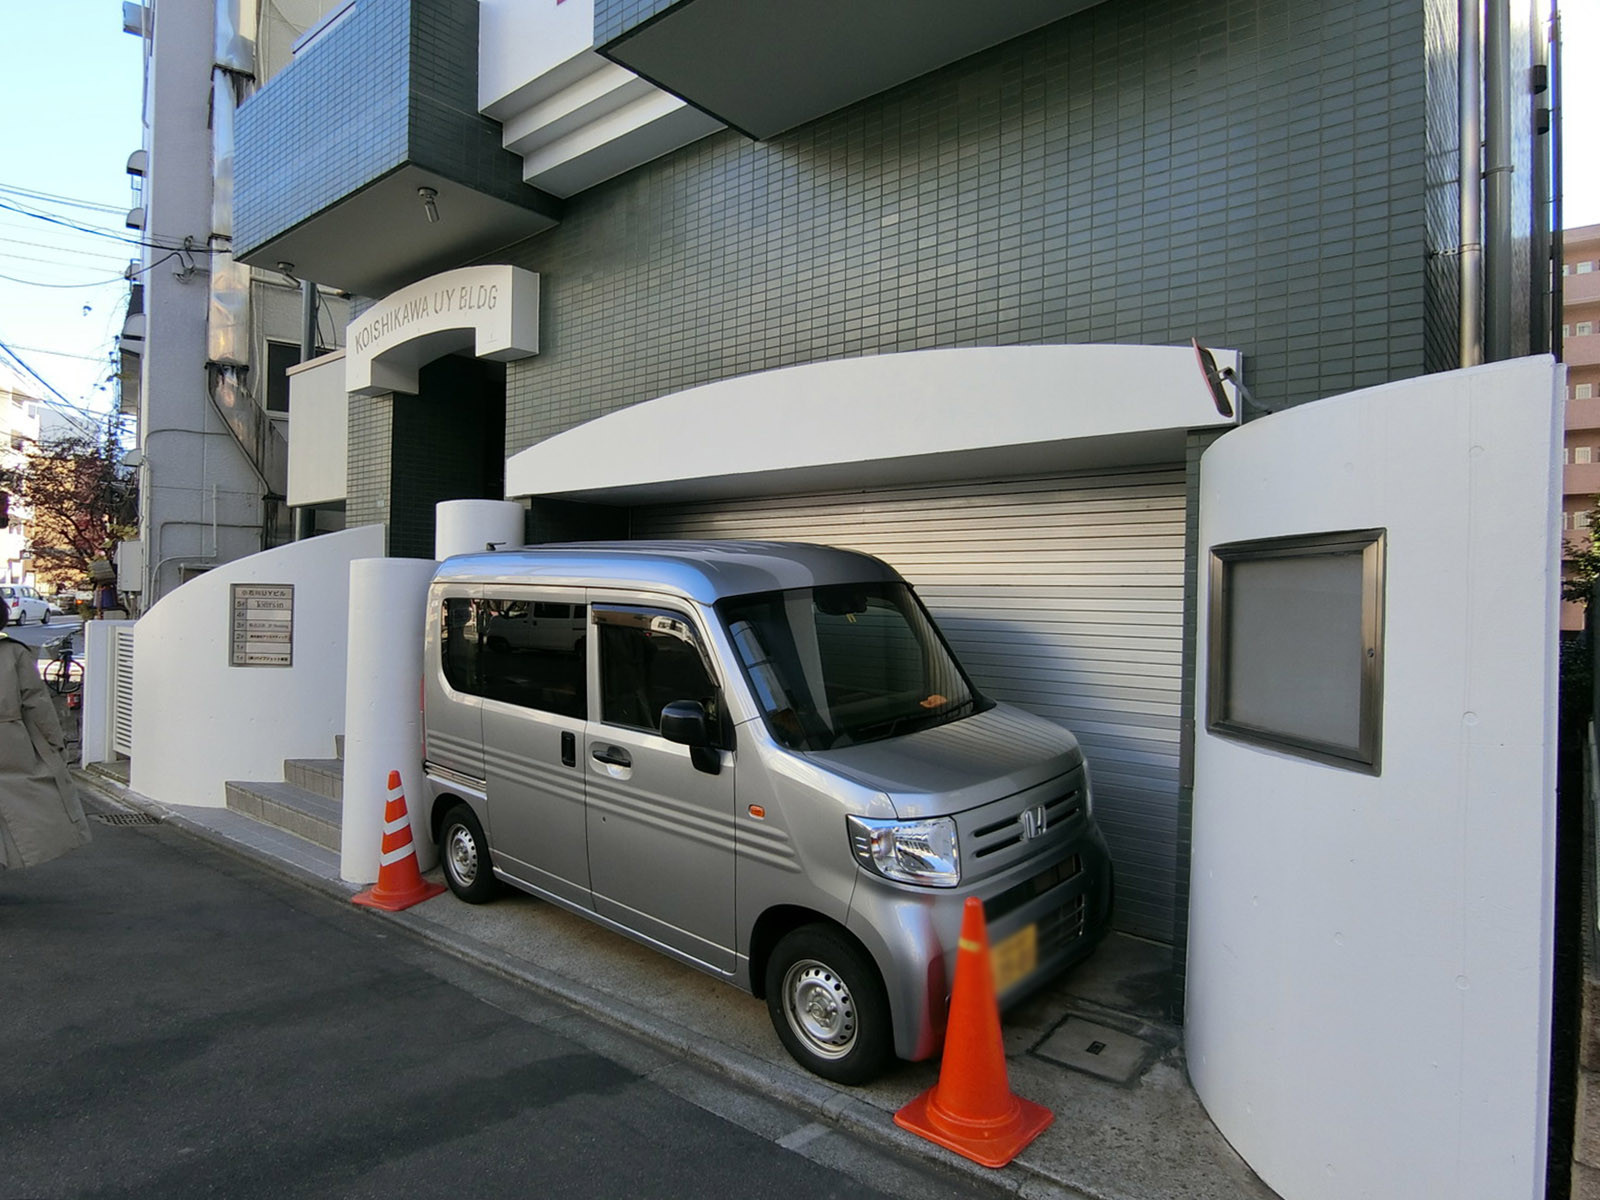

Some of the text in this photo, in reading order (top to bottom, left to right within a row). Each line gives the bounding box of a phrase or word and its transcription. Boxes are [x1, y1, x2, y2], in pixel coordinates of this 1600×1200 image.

[354, 284, 498, 354] KOISHIKAWA UY BLDG
